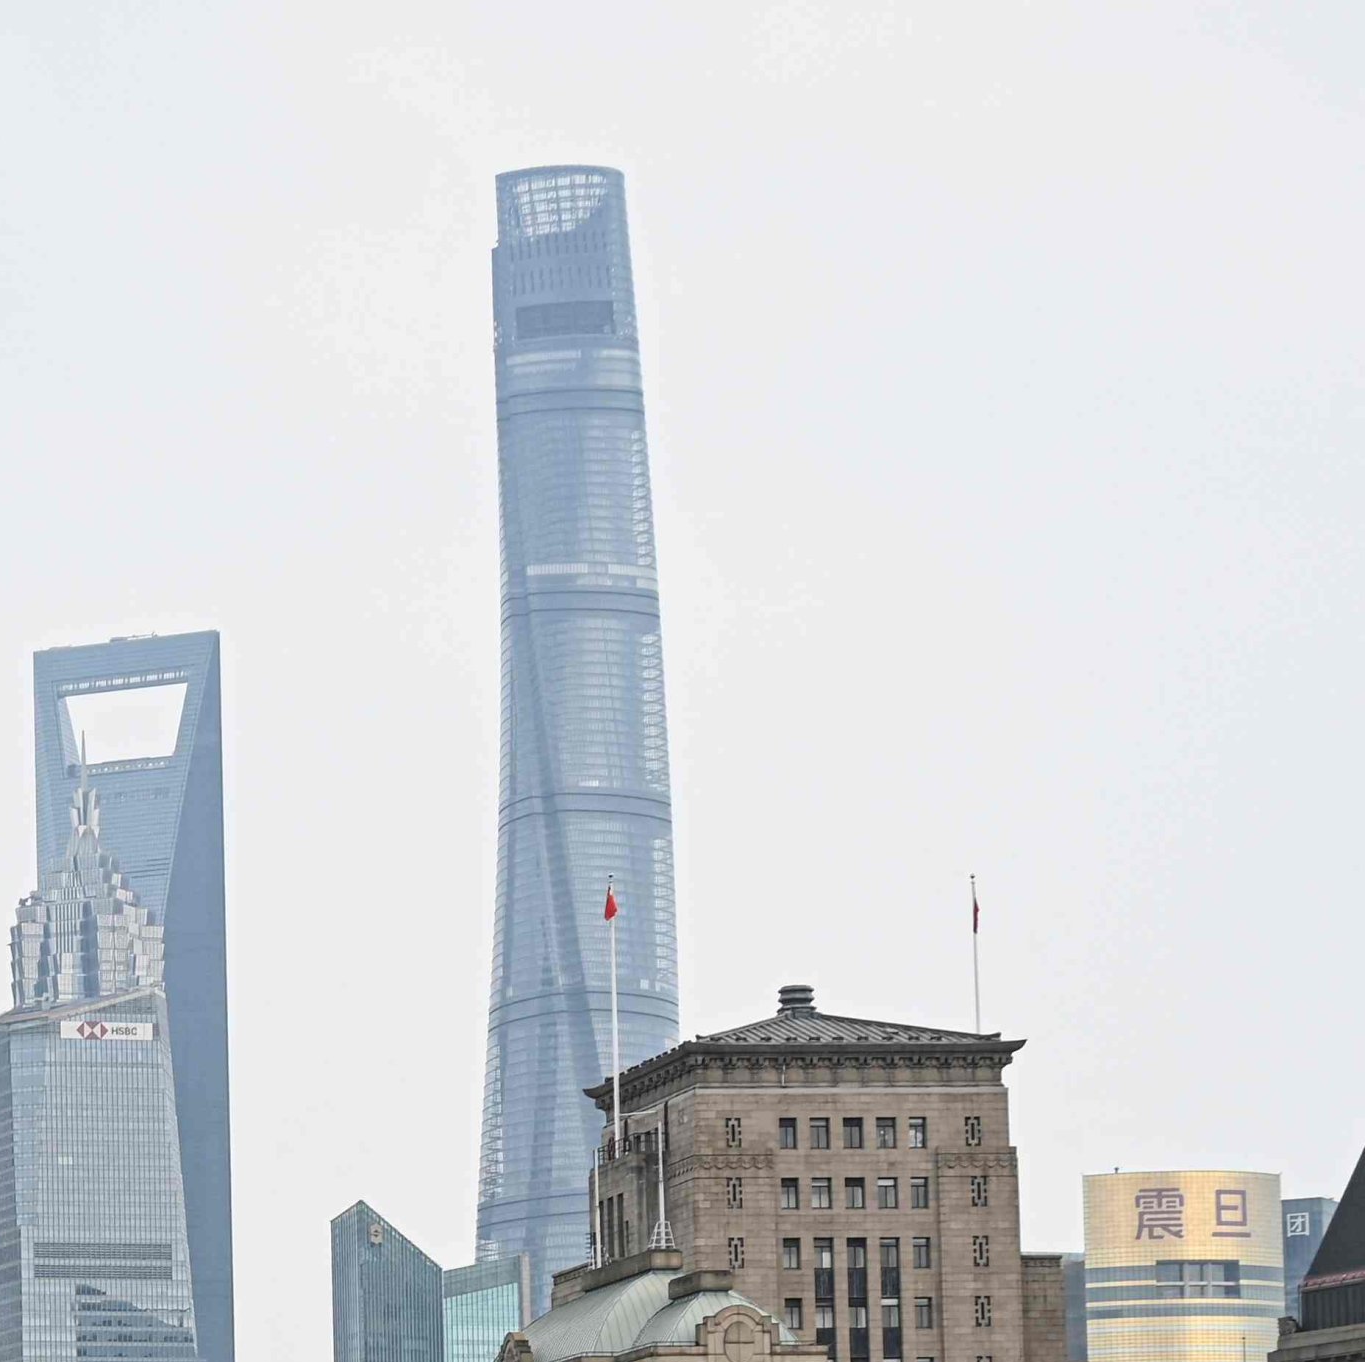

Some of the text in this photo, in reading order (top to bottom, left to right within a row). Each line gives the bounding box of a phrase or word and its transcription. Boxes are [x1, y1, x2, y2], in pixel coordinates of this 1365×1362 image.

[111, 1026, 138, 1036] HSBC
[1135, 1187, 1252, 1240] 震旦
[1286, 1212, 1310, 1237] 团
